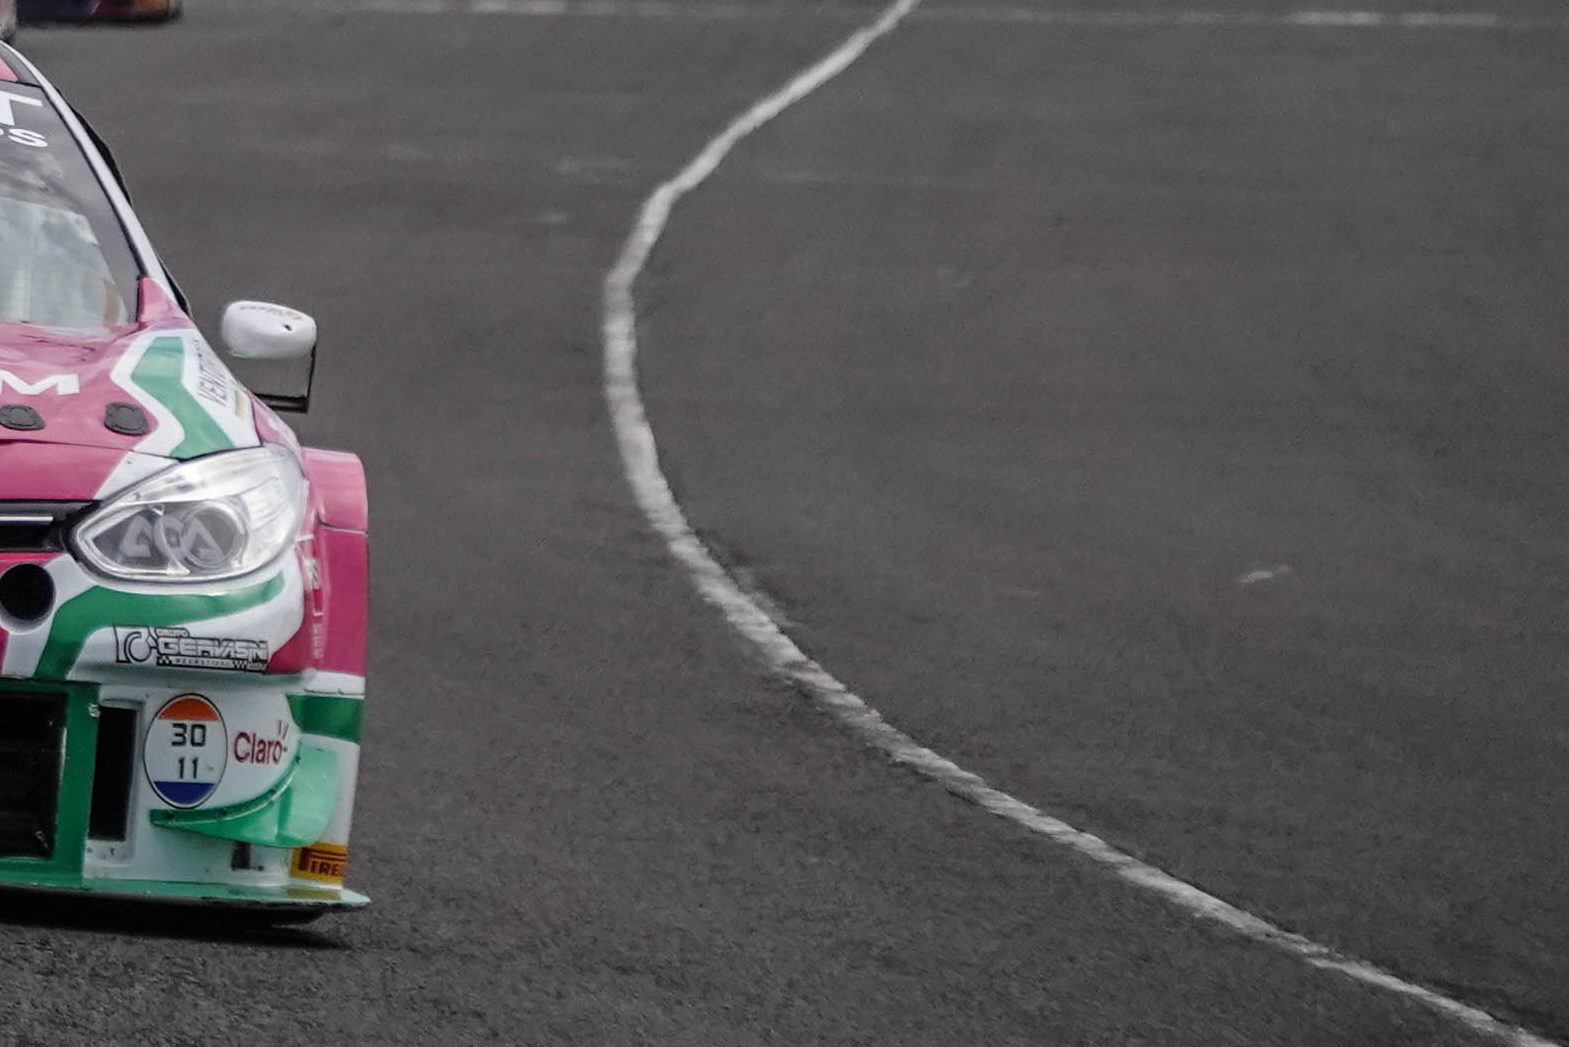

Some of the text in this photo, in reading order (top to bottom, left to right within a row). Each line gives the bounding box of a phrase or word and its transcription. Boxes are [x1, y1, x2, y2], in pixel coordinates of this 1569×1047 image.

[171, 722, 207, 748] 30
[233, 731, 283, 765] Claro
[178, 757, 199, 780] 11
